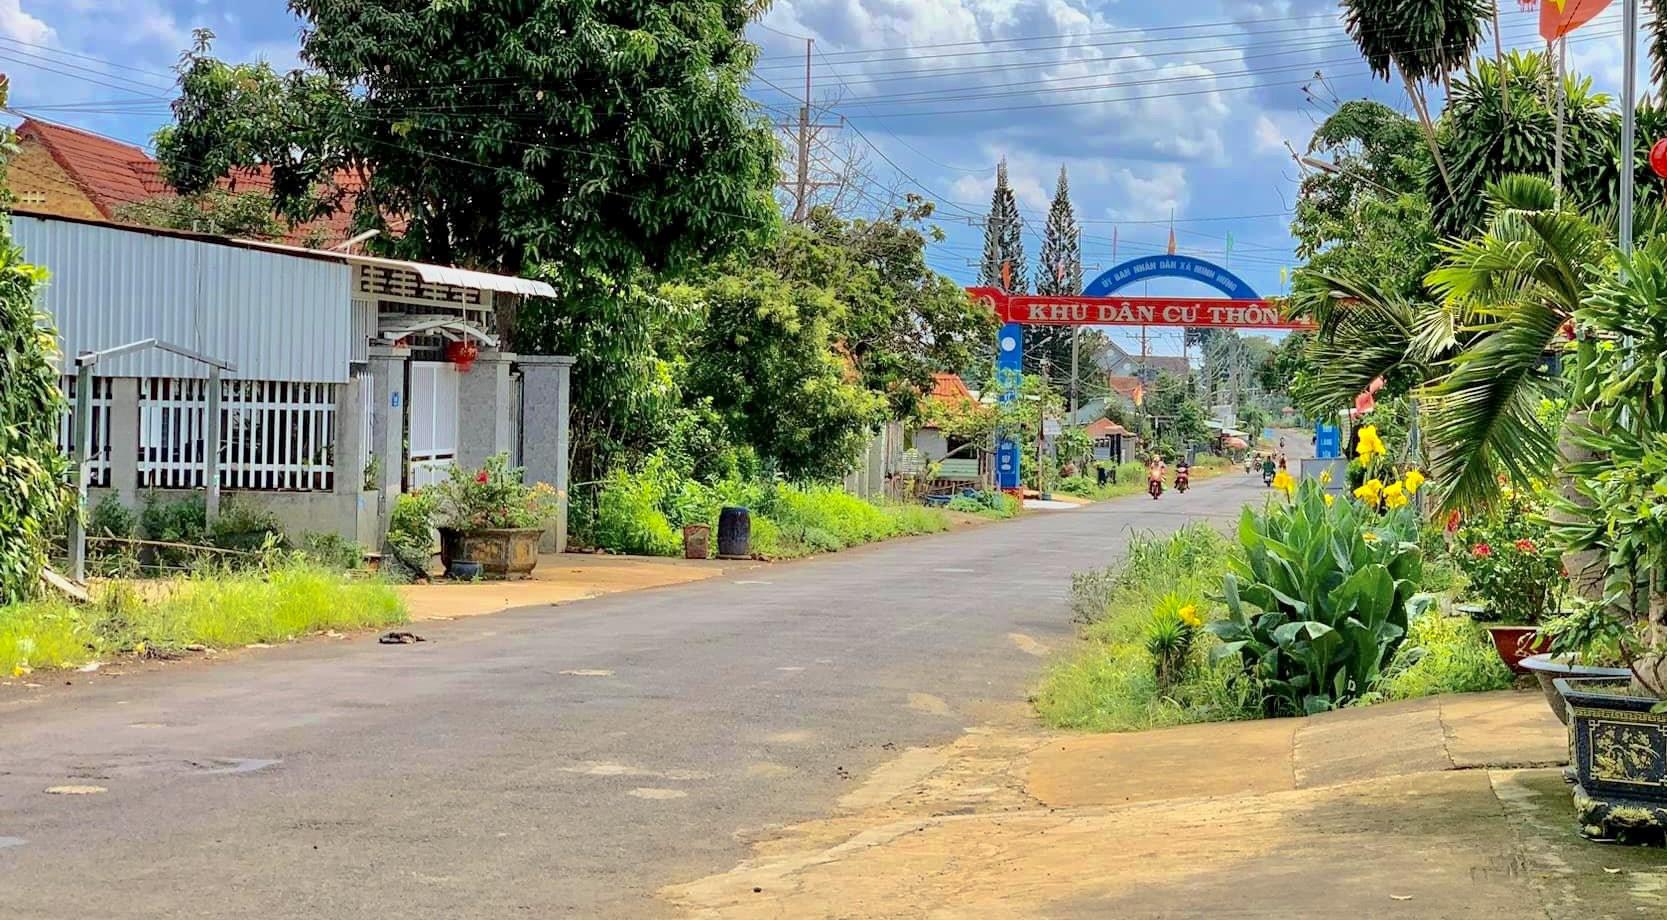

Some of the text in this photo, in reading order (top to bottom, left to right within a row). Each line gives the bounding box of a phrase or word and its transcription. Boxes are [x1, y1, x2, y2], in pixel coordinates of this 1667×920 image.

[1028, 303, 1089, 321] KHU
[1097, 302, 1156, 322] DÂN
[1162, 303, 1200, 323] CƯ
[1208, 304, 1279, 324] THÔN
